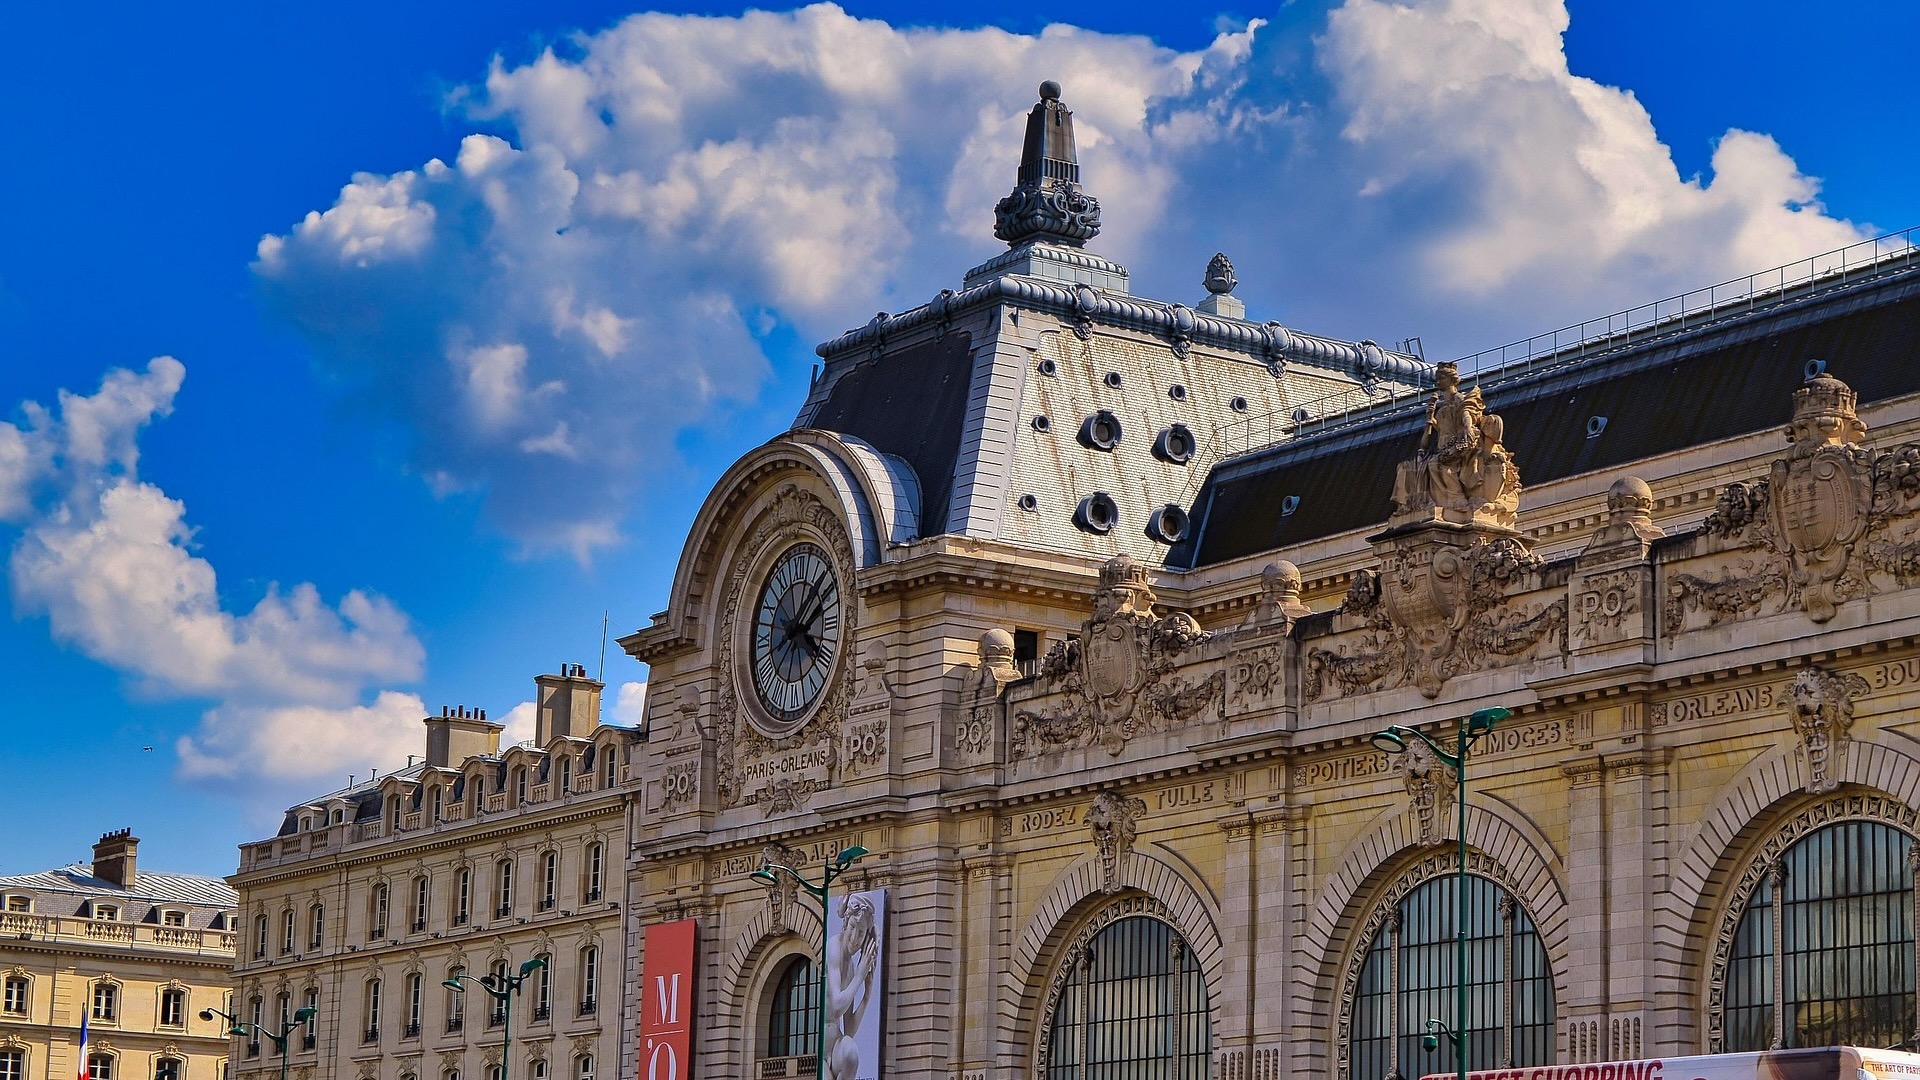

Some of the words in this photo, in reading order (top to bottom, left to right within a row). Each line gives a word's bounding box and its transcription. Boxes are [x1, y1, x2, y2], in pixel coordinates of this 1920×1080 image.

[1582, 588, 1621, 623] PO
[1237, 661, 1269, 691] PO
[1874, 661, 1920, 689] BOU
[1672, 686, 1773, 722] ORLEANS
[851, 732, 876, 760] PO
[955, 721, 982, 749] PO
[1472, 722, 1560, 756] LIMOGES
[746, 750, 826, 780] PARIS-ORLEANS
[1309, 753, 1389, 783] POITIERS
[666, 774, 689, 797] PO
[1154, 782, 1213, 809] TULLE
[1021, 806, 1076, 832] RODEZ
[722, 856, 755, 876] AGEN
[653, 973, 681, 1025] M
[1871, 1063, 1883, 1071] THE
[1885, 1064, 1896, 1072] ART
[1896, 1065, 1905, 1073] OF
